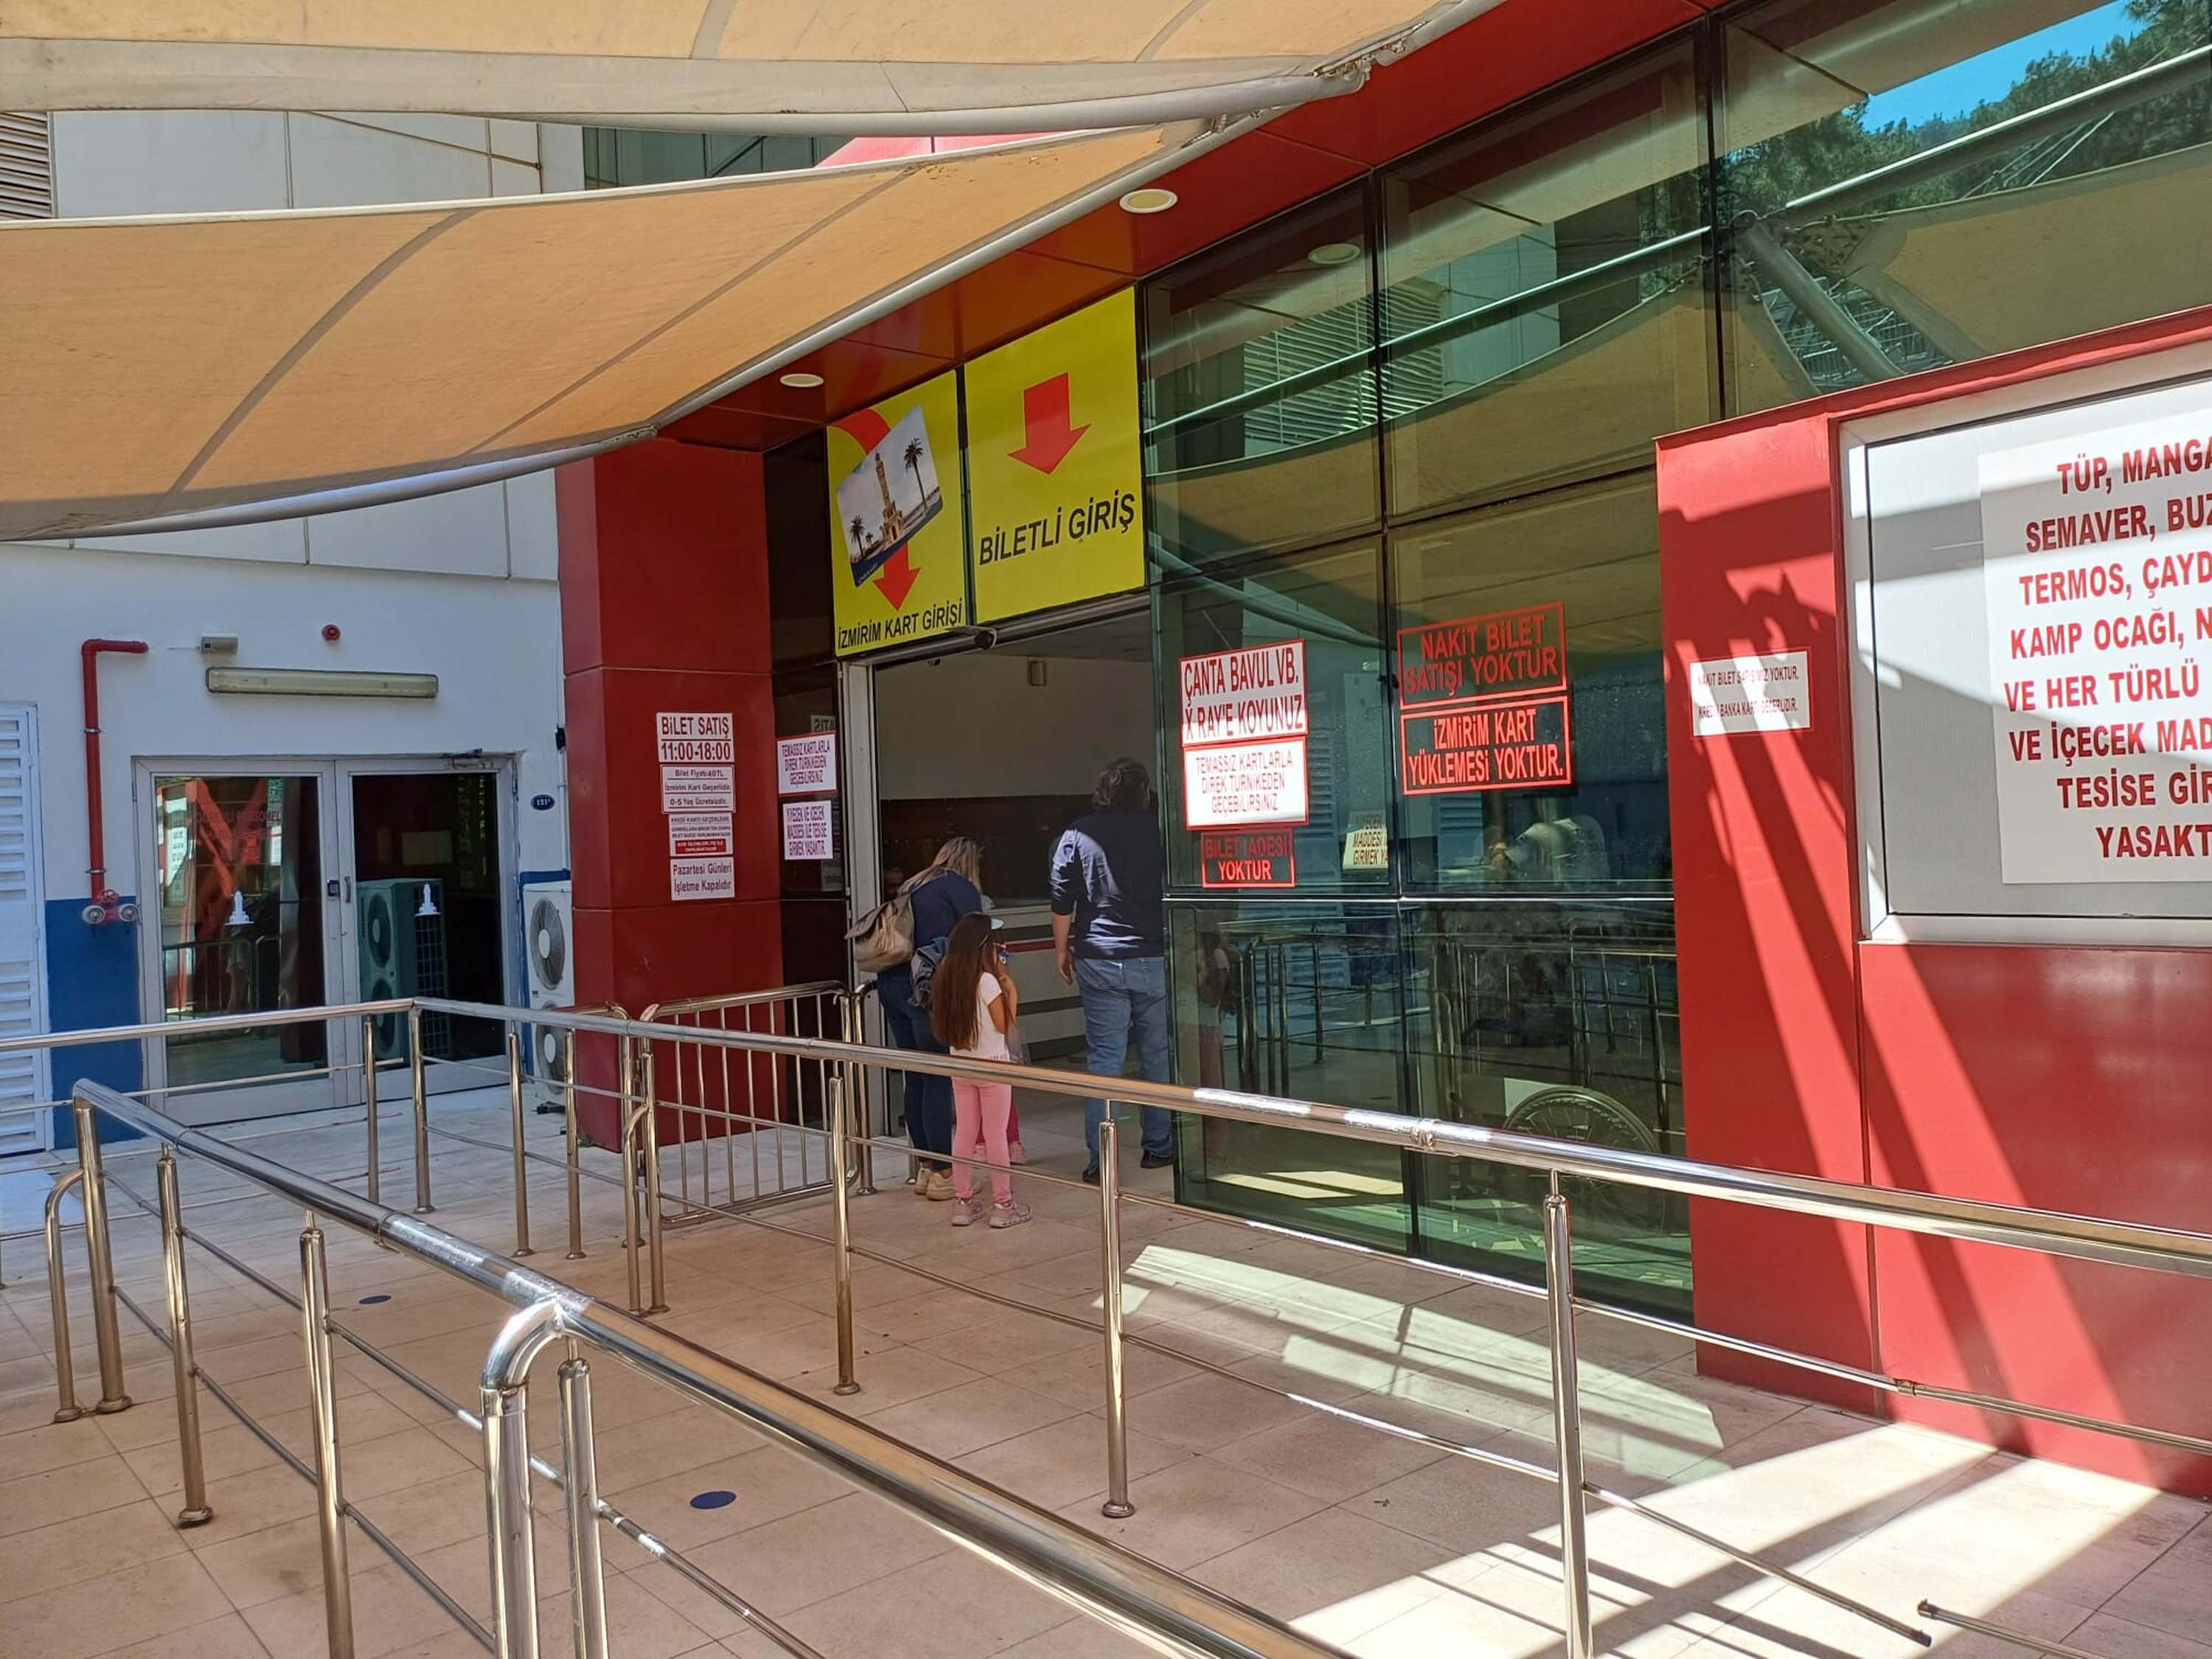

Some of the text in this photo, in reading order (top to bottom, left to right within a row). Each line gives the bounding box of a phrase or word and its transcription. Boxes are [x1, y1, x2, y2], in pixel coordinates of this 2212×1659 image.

[2057, 453, 2112, 494] TÜP,
[979, 490, 1135, 566] BİLETLİ GİRİŞ
[2026, 505, 2156, 553] SEMAVER,
[2019, 551, 2212, 606] TERMOS, ÇAYD
[838, 598, 962, 650] İZMİRİM KART GİRİŞİ
[1421, 613, 1545, 661] NAKİT BİLET
[2011, 623, 2082, 660] KAMP
[2094, 607, 2184, 650] OCAĞI,
[1185, 647, 1298, 706] ÇANTA BAVUL VB.
[1405, 646, 1558, 697] SATIŞI YOKTUR
[1770, 667, 1799, 681] YOKTUR.
[2004, 658, 2199, 712] VE HER TÜRLÜ
[661, 716, 729, 738] BİLET SATIŞ
[1186, 695, 1303, 739] X RAY'E KOYUNUZ
[1433, 709, 1536, 750] İZMİRİM KART
[661, 742, 730, 760] 11:00-18:00
[1239, 750, 1293, 771] KARTLARLA
[1409, 744, 1564, 786] YÜKLEMESİ YOKTUR.
[2009, 730, 2042, 762] VE
[2051, 721, 2146, 767] İÇECEK
[2056, 768, 2156, 809] TESİSE
[673, 860, 732, 875] Pazartesi Günleri
[674, 879, 700, 895] İşletme
[1218, 860, 1272, 880] YOKTUR
